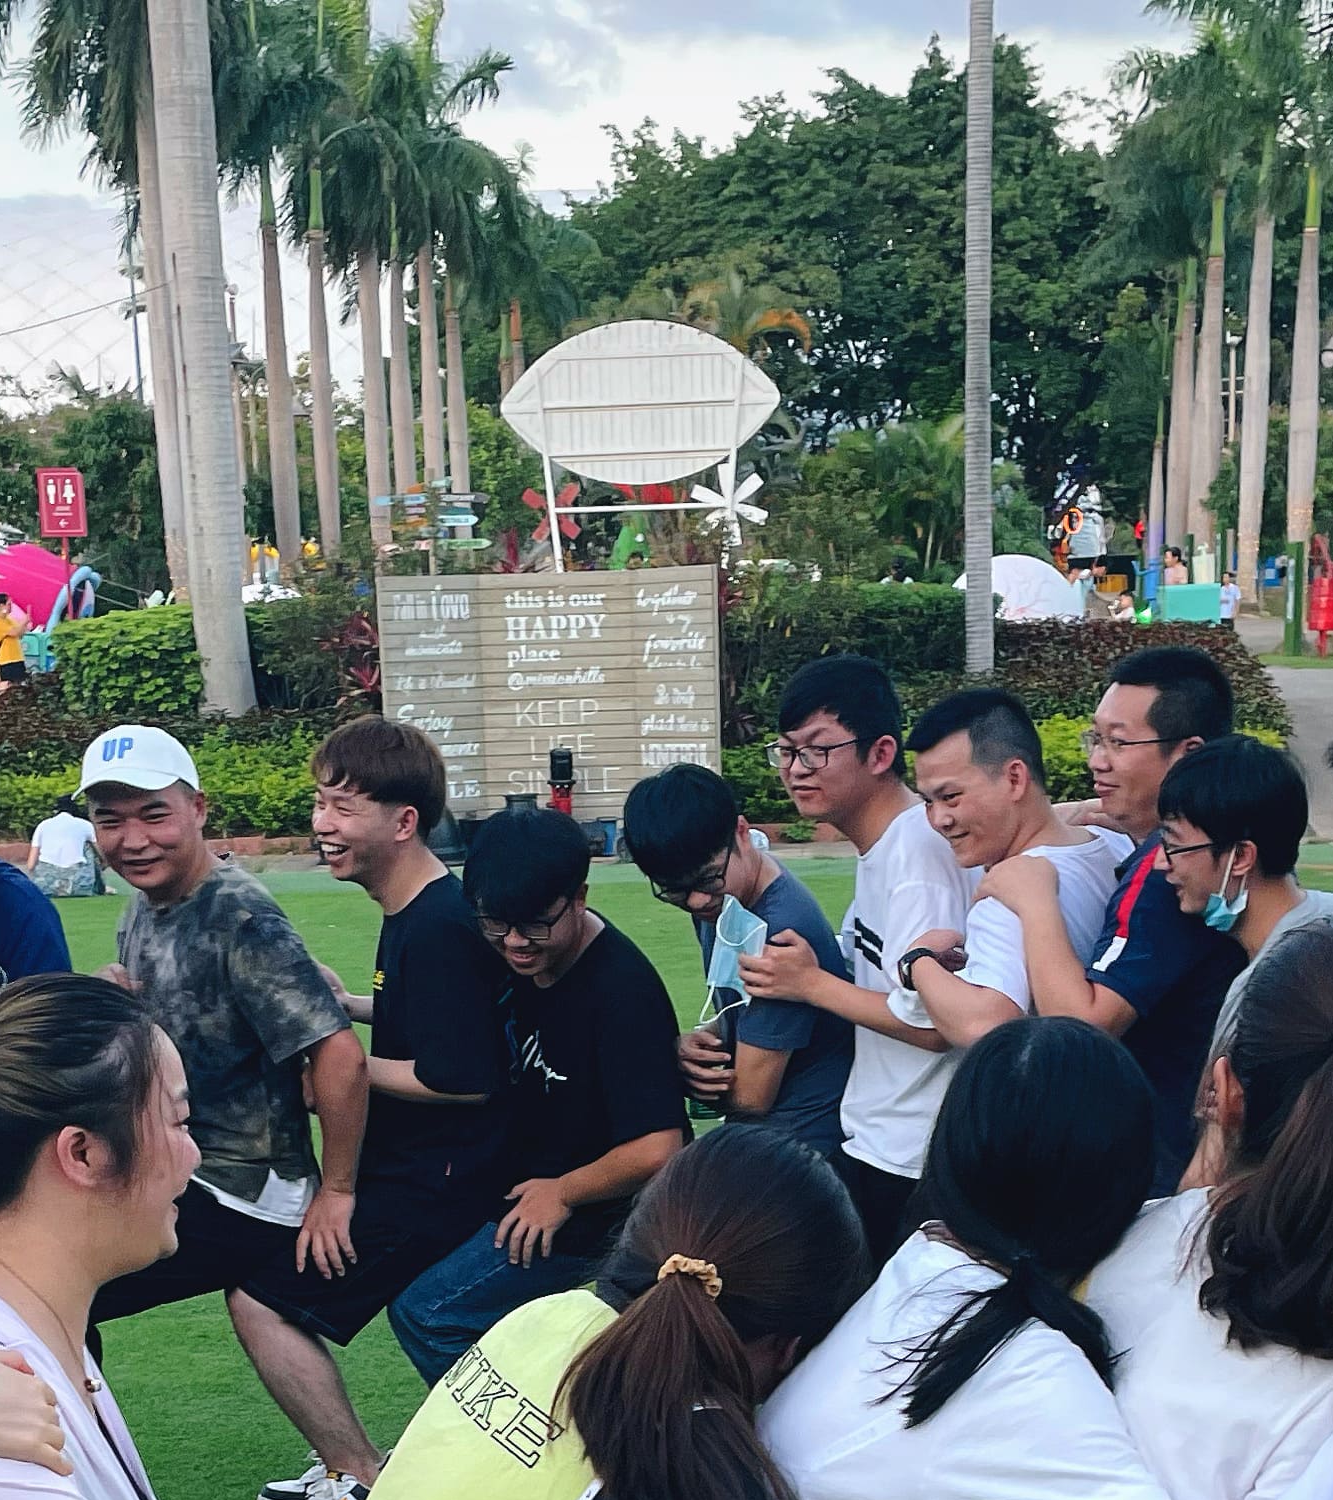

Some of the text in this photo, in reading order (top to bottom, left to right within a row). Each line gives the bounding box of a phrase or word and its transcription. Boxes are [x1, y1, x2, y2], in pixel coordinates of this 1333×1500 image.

[505, 589, 606, 609] this is our
[504, 613, 607, 640] HAPPY
[507, 645, 561, 668] place
[515, 698, 600, 727] KEEP
[102, 737, 134, 762] UP
[530, 733, 598, 761] LIFE
[445, 1345, 565, 1468] NIKE
